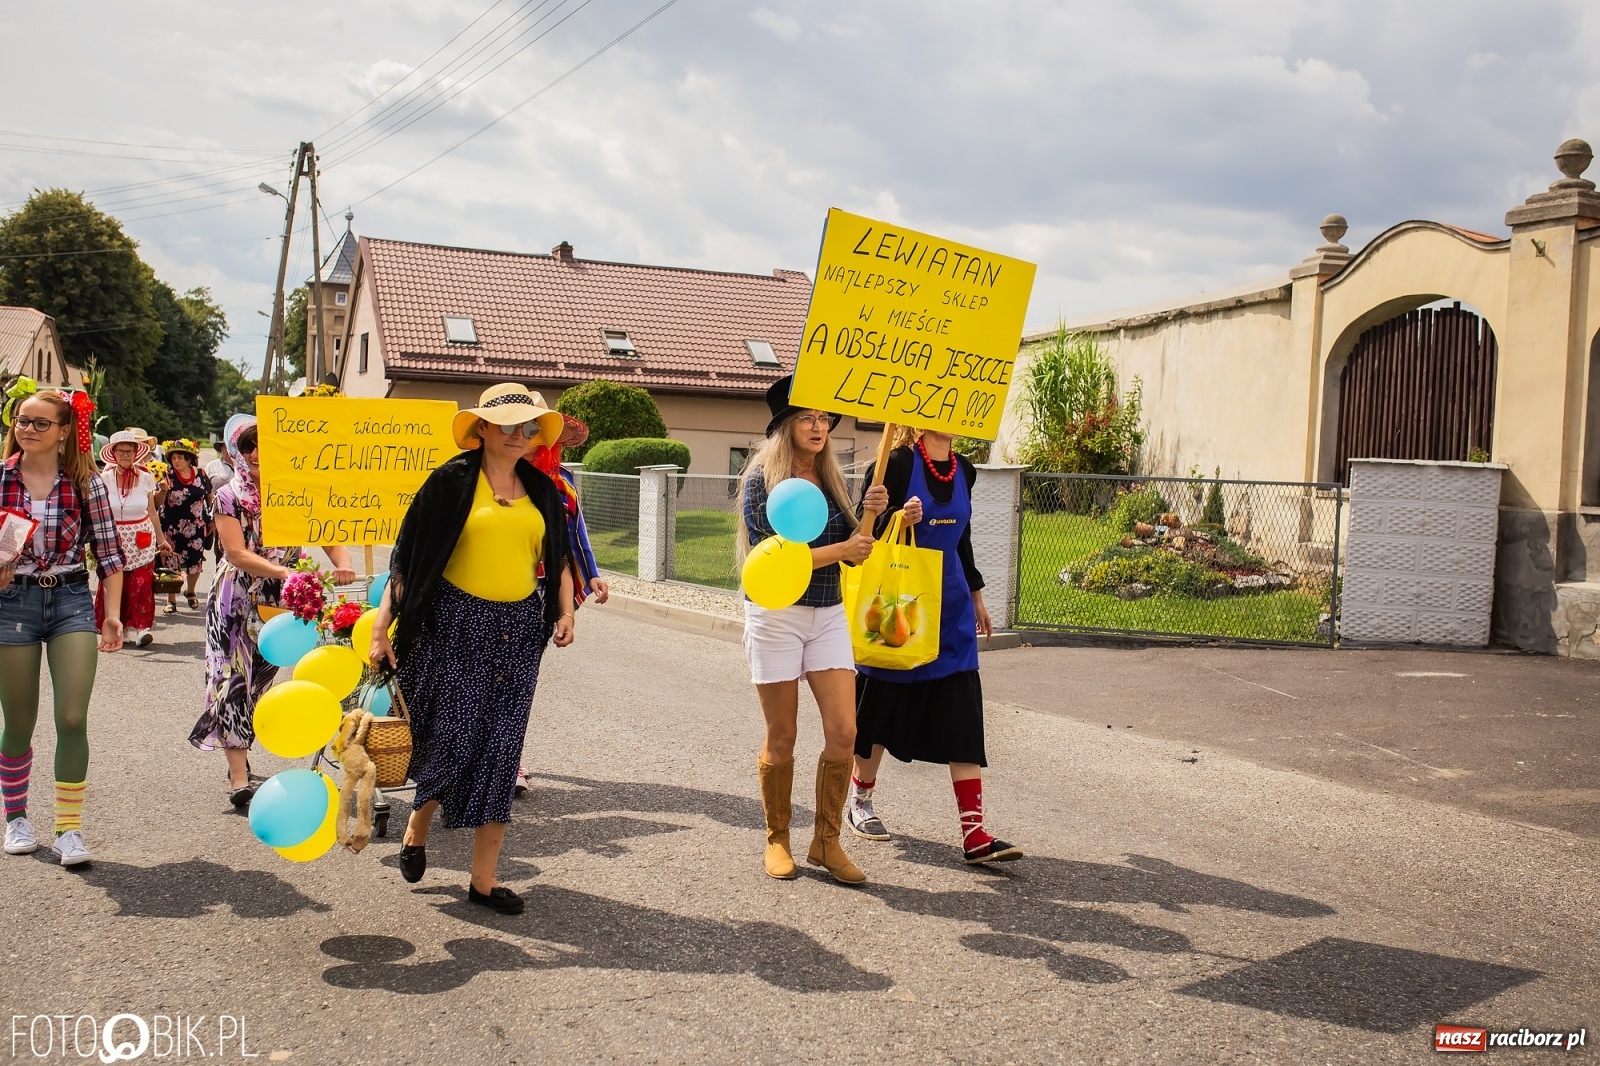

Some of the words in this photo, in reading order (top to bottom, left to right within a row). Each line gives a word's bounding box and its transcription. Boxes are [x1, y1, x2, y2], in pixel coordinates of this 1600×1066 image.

[852, 227, 1002, 288] LEWIATAN
[823, 264, 920, 297] NAJLEPSZY
[942, 290, 989, 311] SKLEP
[859, 304, 874, 322] W
[887, 309, 952, 335] MIEŚCIE
[807, 323, 828, 355] A
[835, 327, 932, 371] OBSŁUGA
[937, 347, 1014, 385] JESZCZE
[273, 408, 329, 433] Rzecz
[354, 416, 433, 436] wiadoma
[266, 483, 313, 518] każdy
